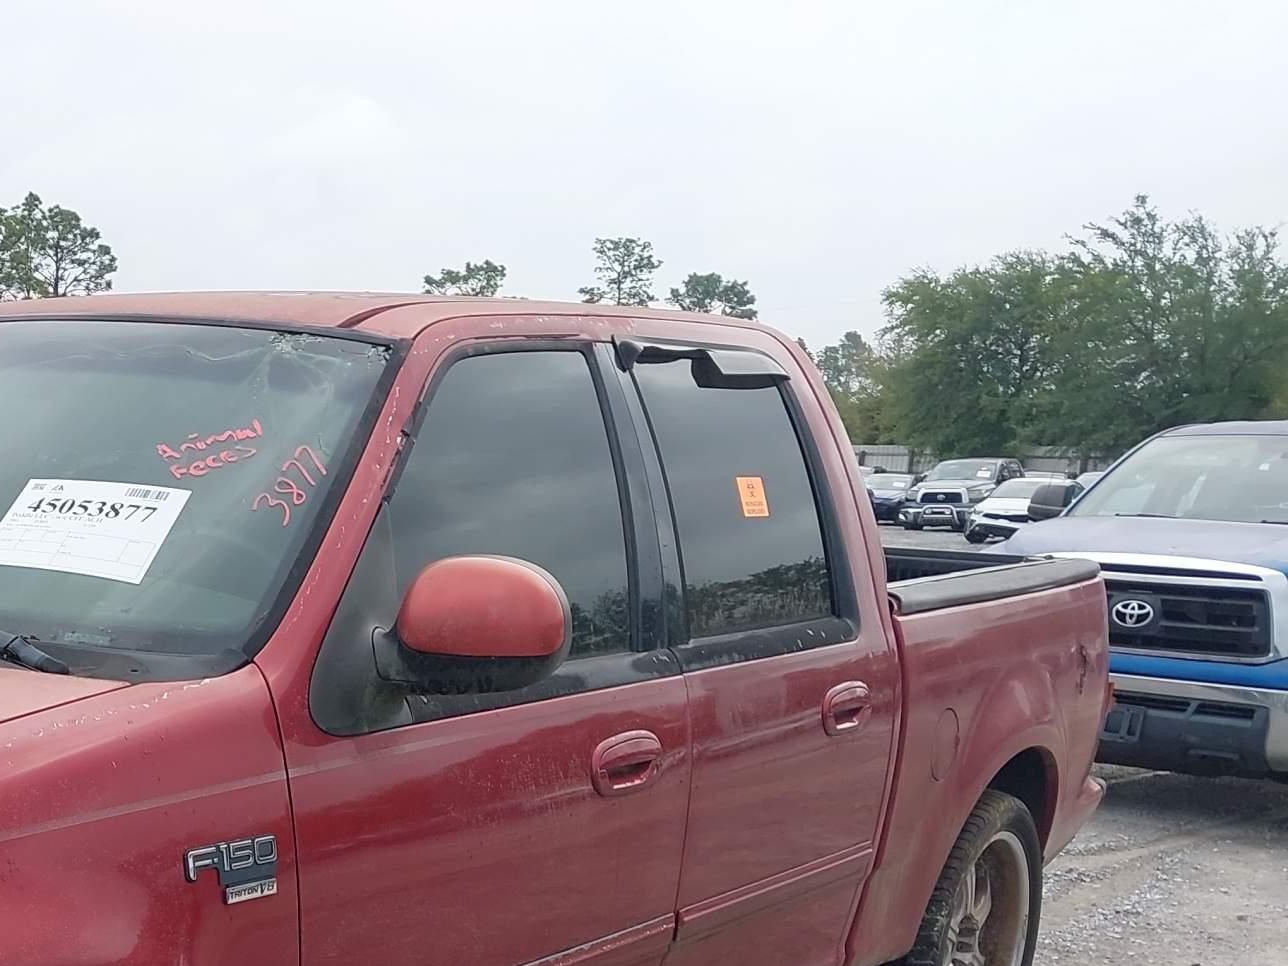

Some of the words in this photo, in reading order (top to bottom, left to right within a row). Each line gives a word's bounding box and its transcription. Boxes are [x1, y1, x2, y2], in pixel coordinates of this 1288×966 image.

[252, 445, 327, 527] 3877
[27, 497, 159, 523] 45053877
[187, 835, 278, 881] F-150
[229, 886, 259, 900] TRITON
[259, 881, 276, 895] V8
